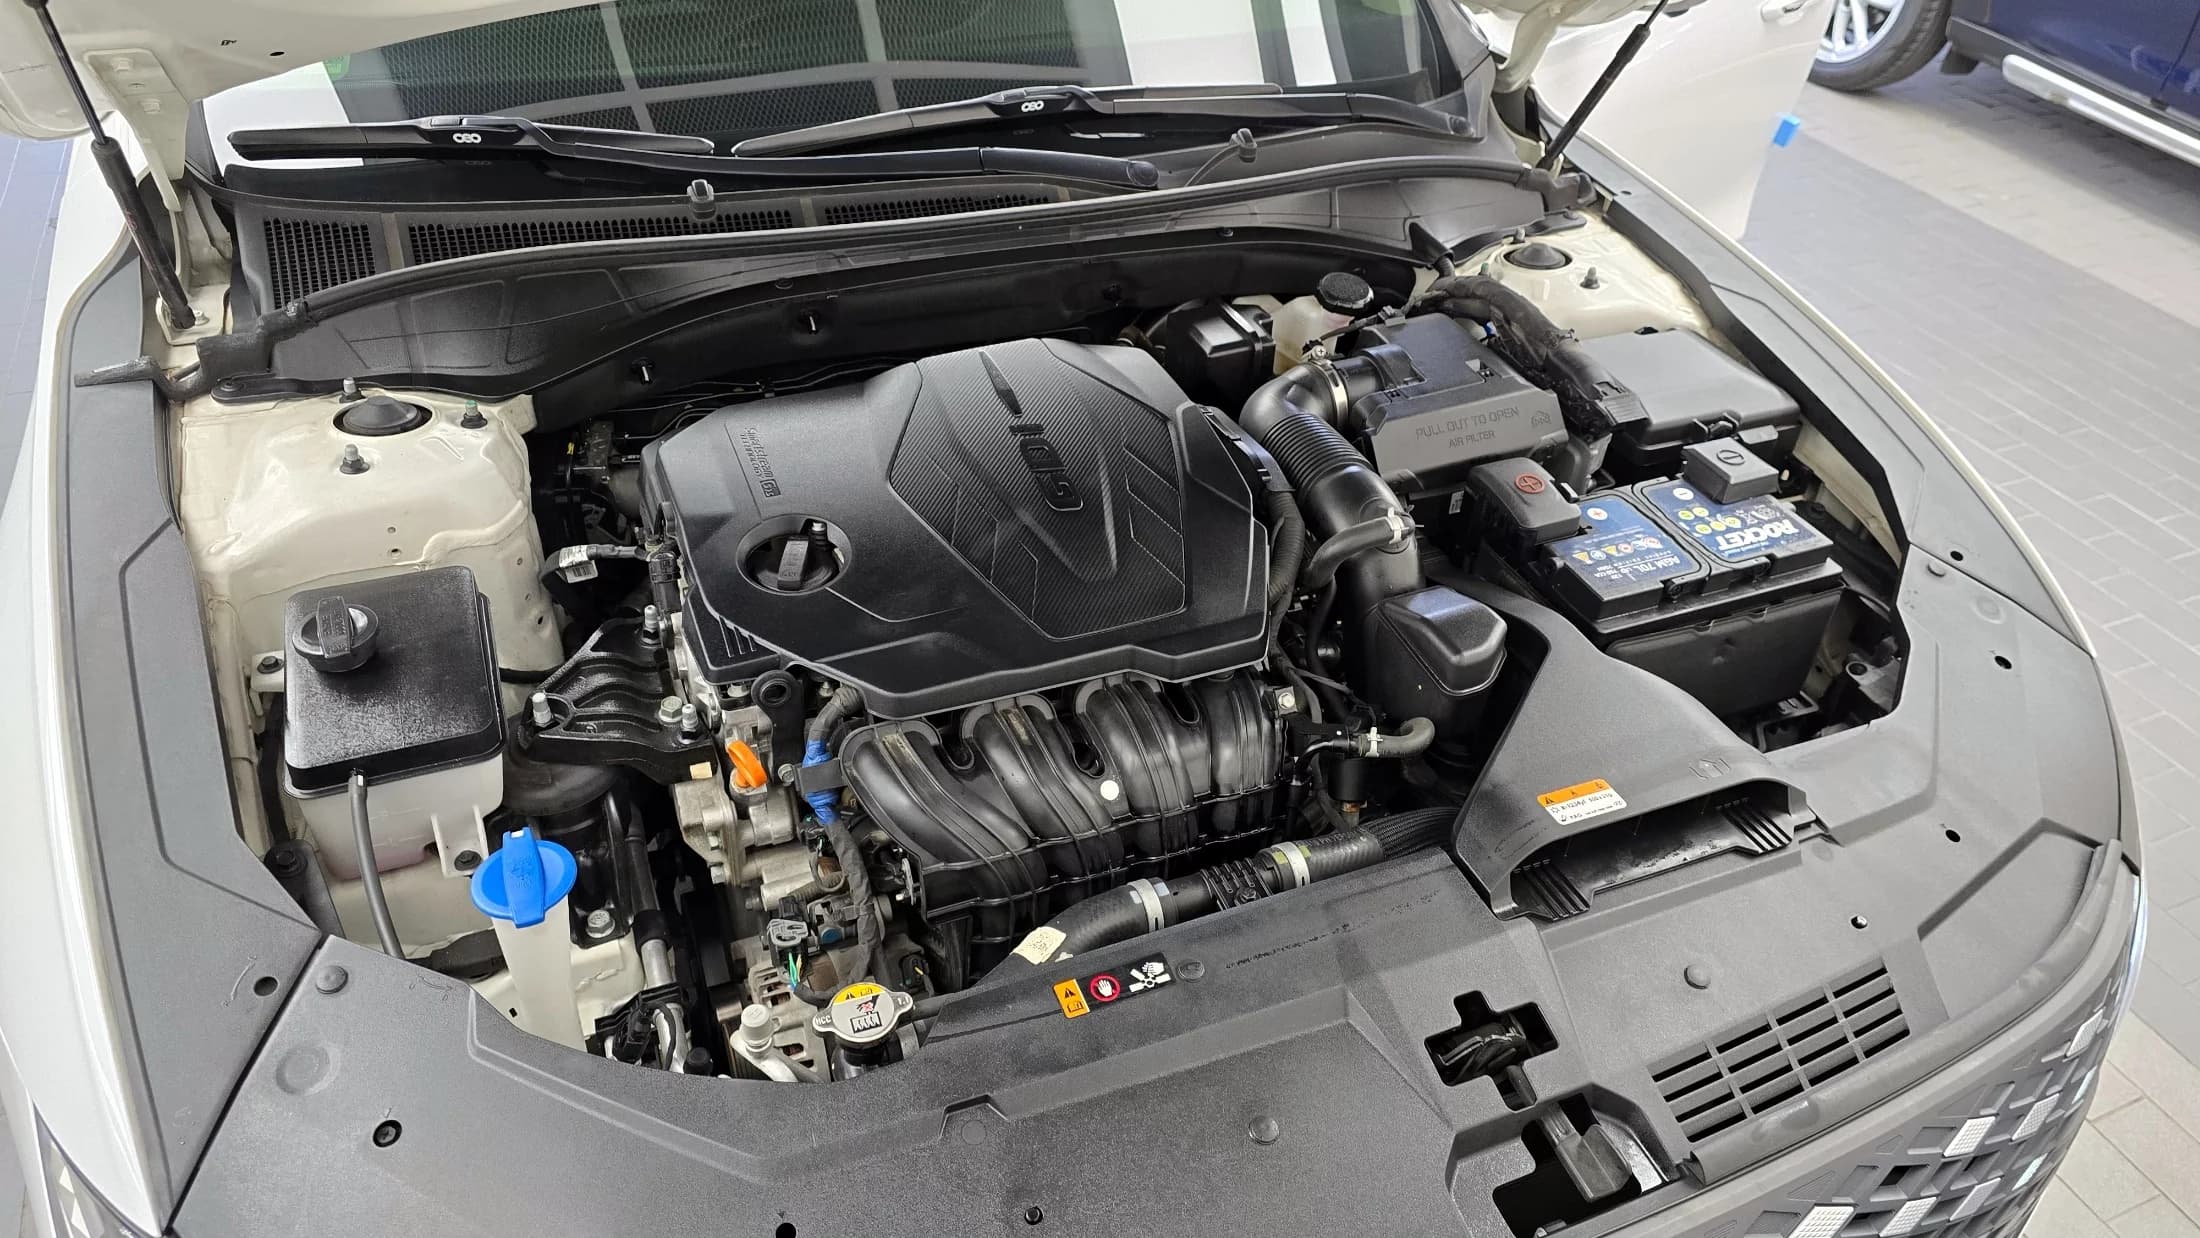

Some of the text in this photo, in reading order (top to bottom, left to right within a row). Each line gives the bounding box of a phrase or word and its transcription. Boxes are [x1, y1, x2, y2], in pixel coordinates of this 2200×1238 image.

[1415, 423, 1444, 441] PULL
[1447, 418, 1471, 433] OUT
[1473, 414, 1488, 427] TO
[1489, 406, 1521, 422] OPEN
[1449, 430, 1495, 449] AIR FILTER
[1715, 519, 1799, 551] ROCKET
[1655, 556, 1681, 569] AGM
